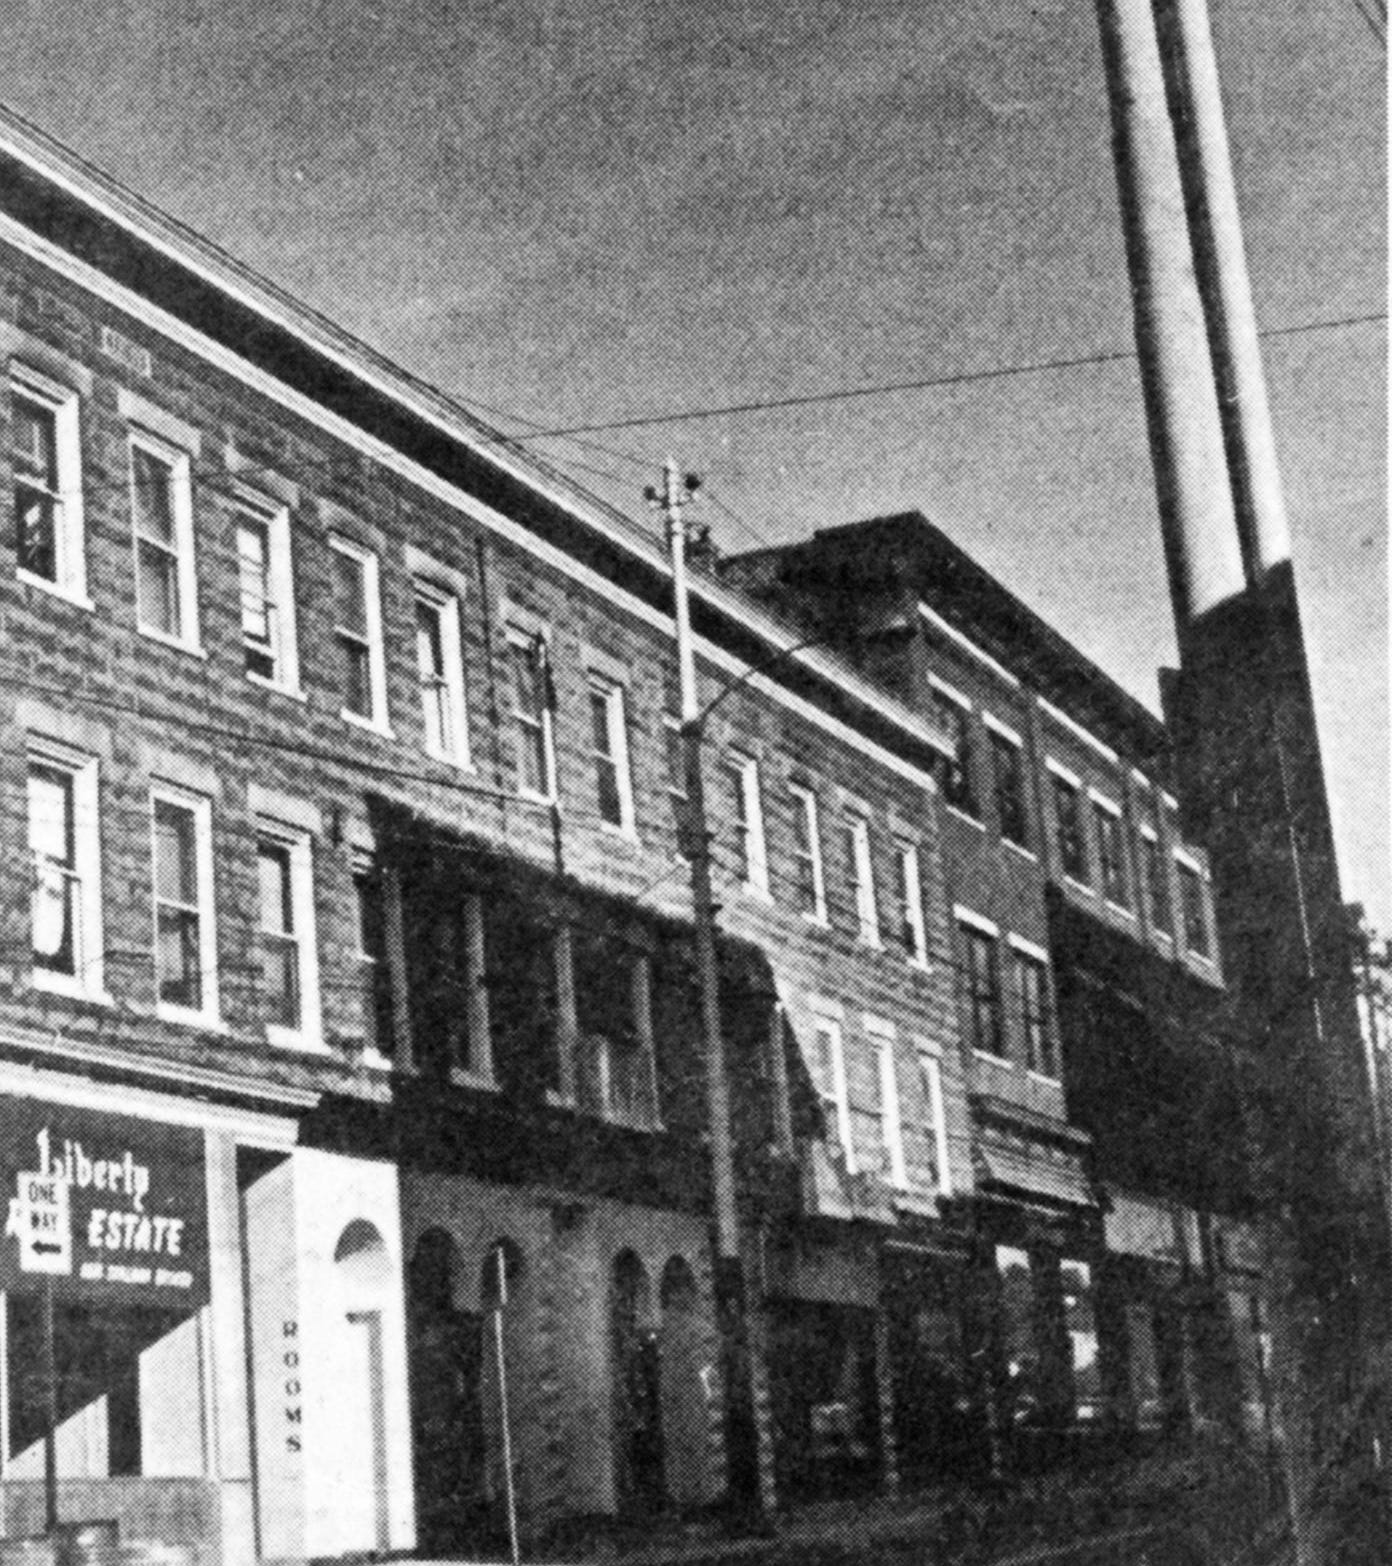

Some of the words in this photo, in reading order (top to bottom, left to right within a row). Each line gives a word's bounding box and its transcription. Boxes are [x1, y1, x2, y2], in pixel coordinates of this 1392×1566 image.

[28, 1180, 59, 1205] ONE
[36, 1126, 150, 1212] Liberty
[88, 1208, 185, 1256] ESTATE
[282, 1320, 302, 1453] ROOMS
